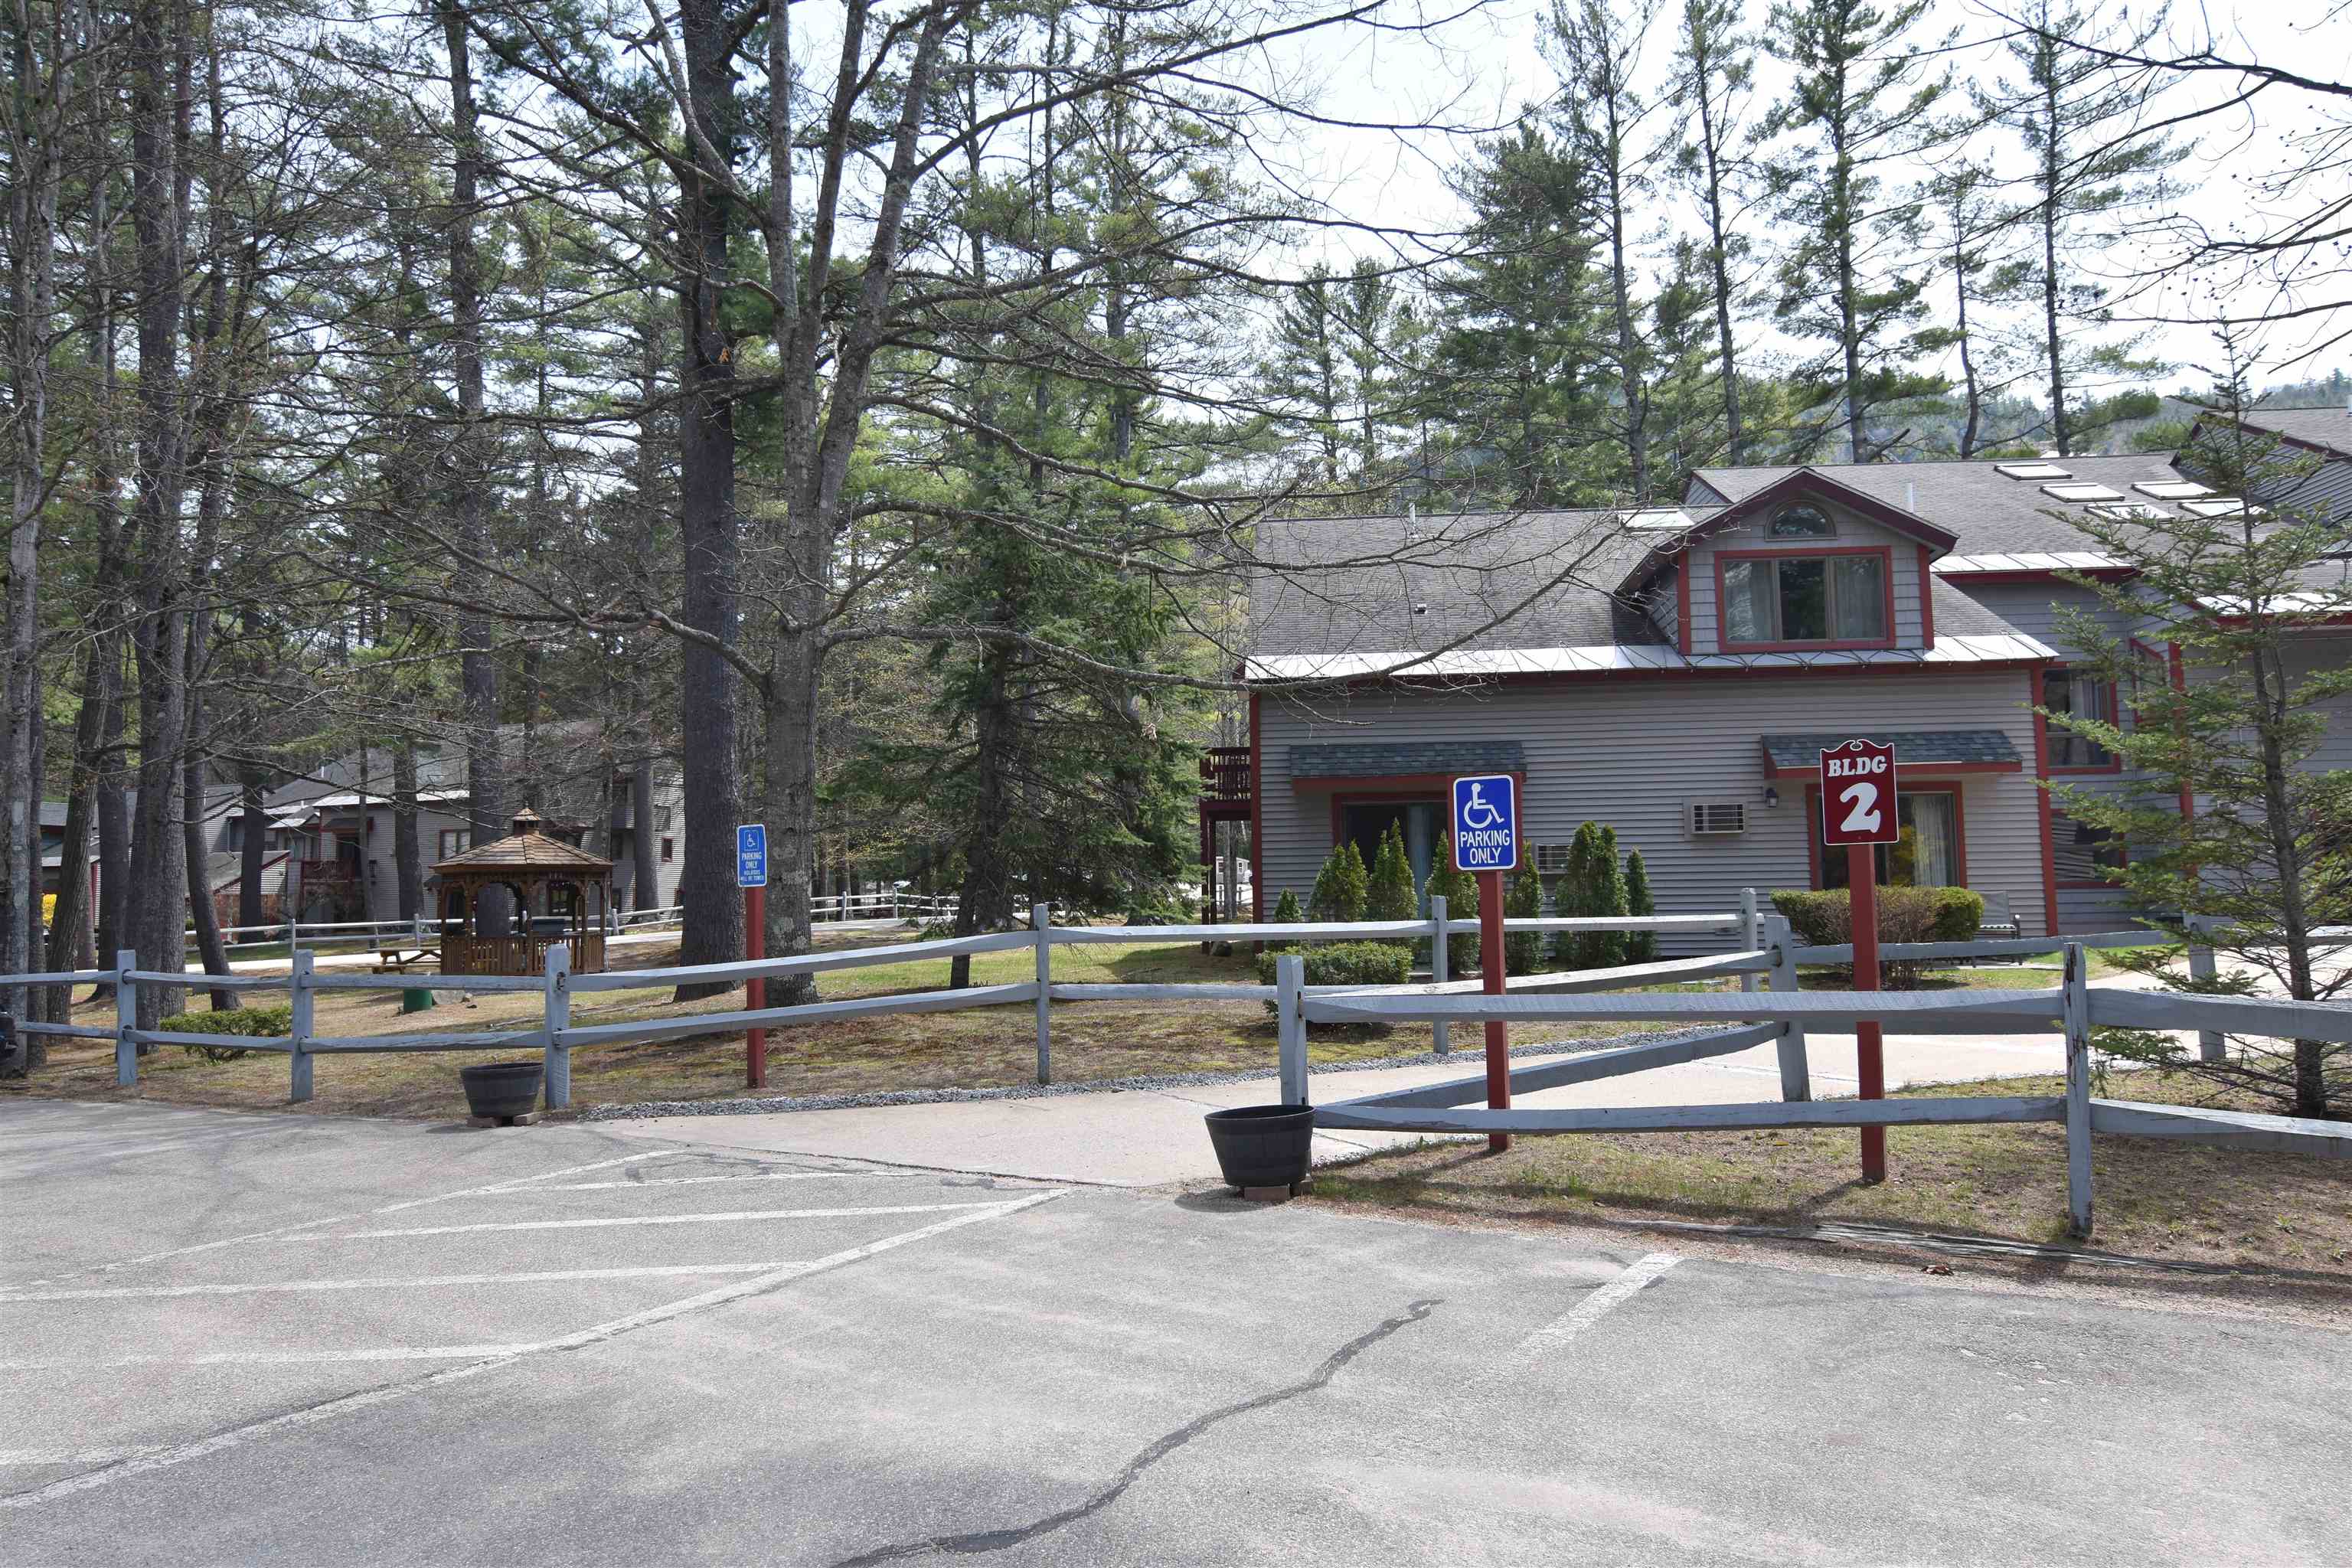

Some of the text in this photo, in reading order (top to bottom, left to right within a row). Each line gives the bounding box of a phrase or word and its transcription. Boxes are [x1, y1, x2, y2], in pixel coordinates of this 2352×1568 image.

[1828, 756, 1887, 777] BLDG
[1839, 782, 1881, 834] 2
[1460, 829, 1510, 848] PARKING
[741, 851, 763, 861] PARKING
[1470, 847, 1501, 864] ONLY
[745, 860, 758, 870] ONLY
